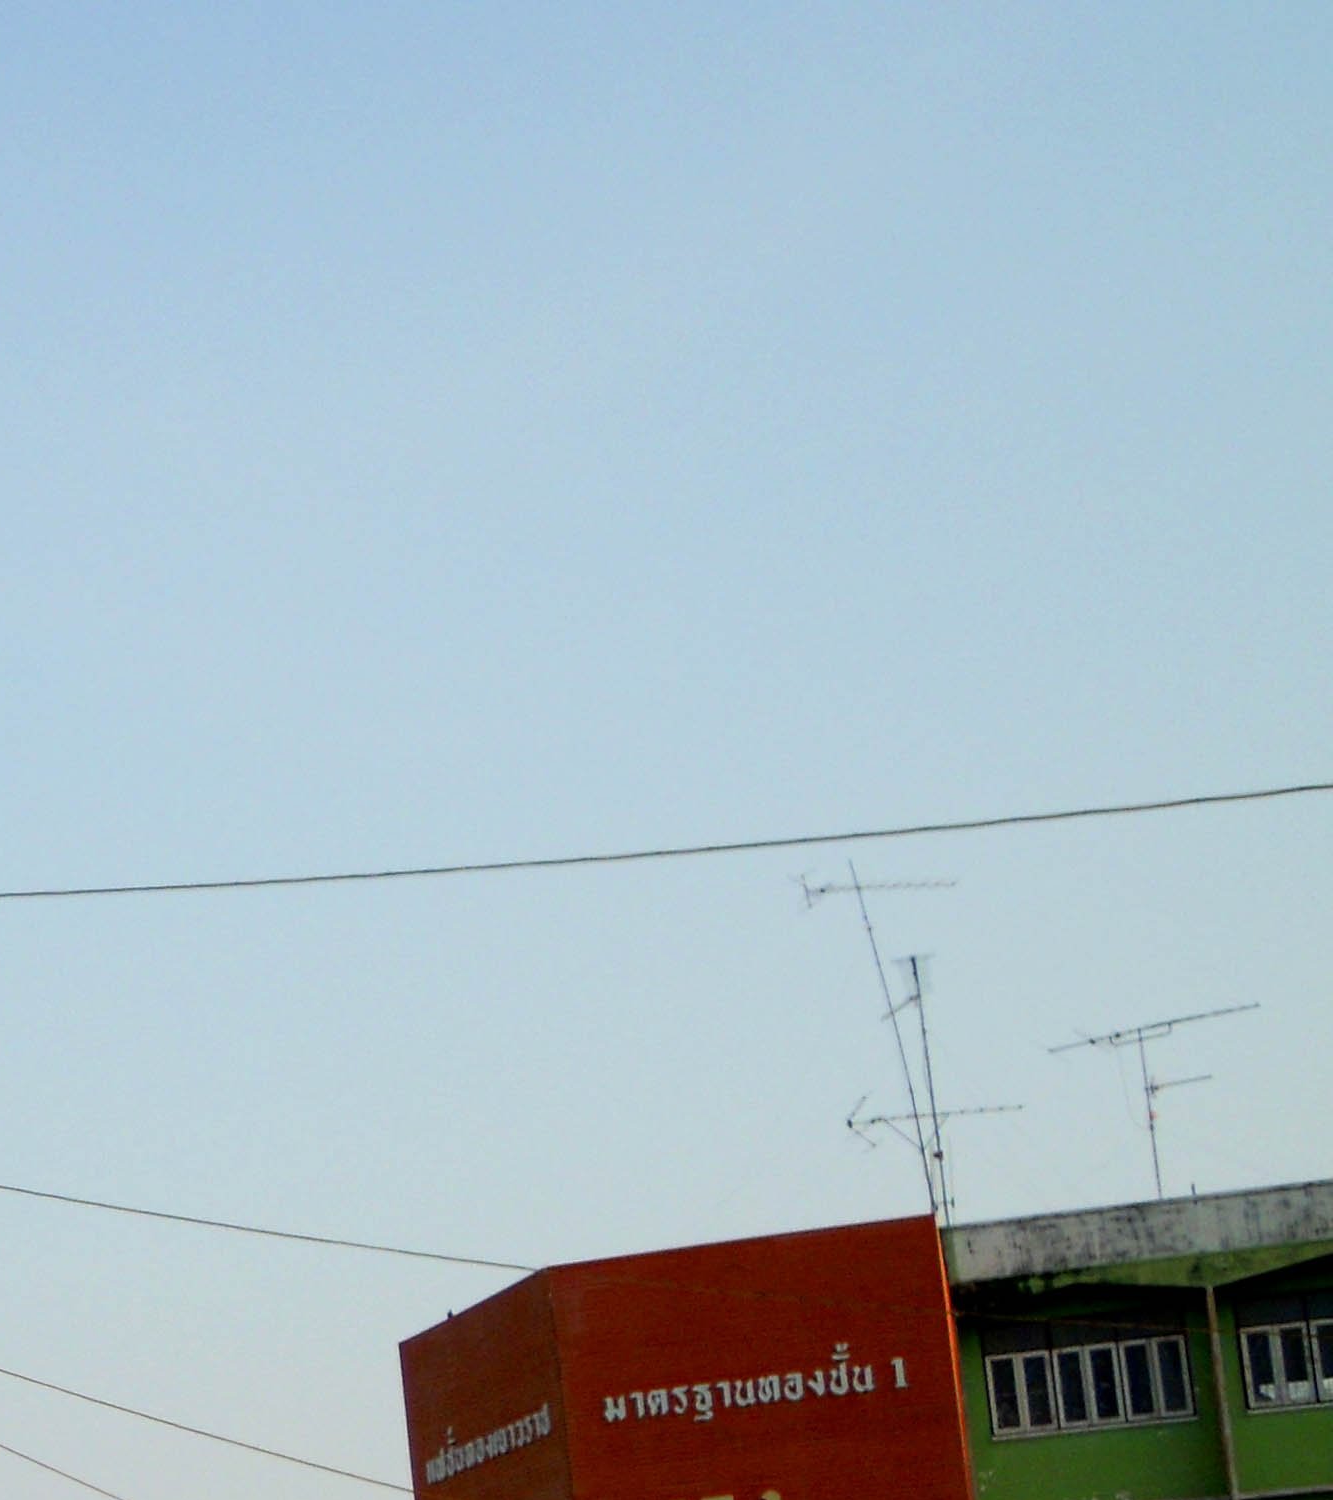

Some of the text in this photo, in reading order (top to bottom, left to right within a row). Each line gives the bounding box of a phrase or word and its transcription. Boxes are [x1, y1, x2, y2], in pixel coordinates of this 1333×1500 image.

[604, 1342, 909, 1422] มาตรฐานทองชั้น 1
